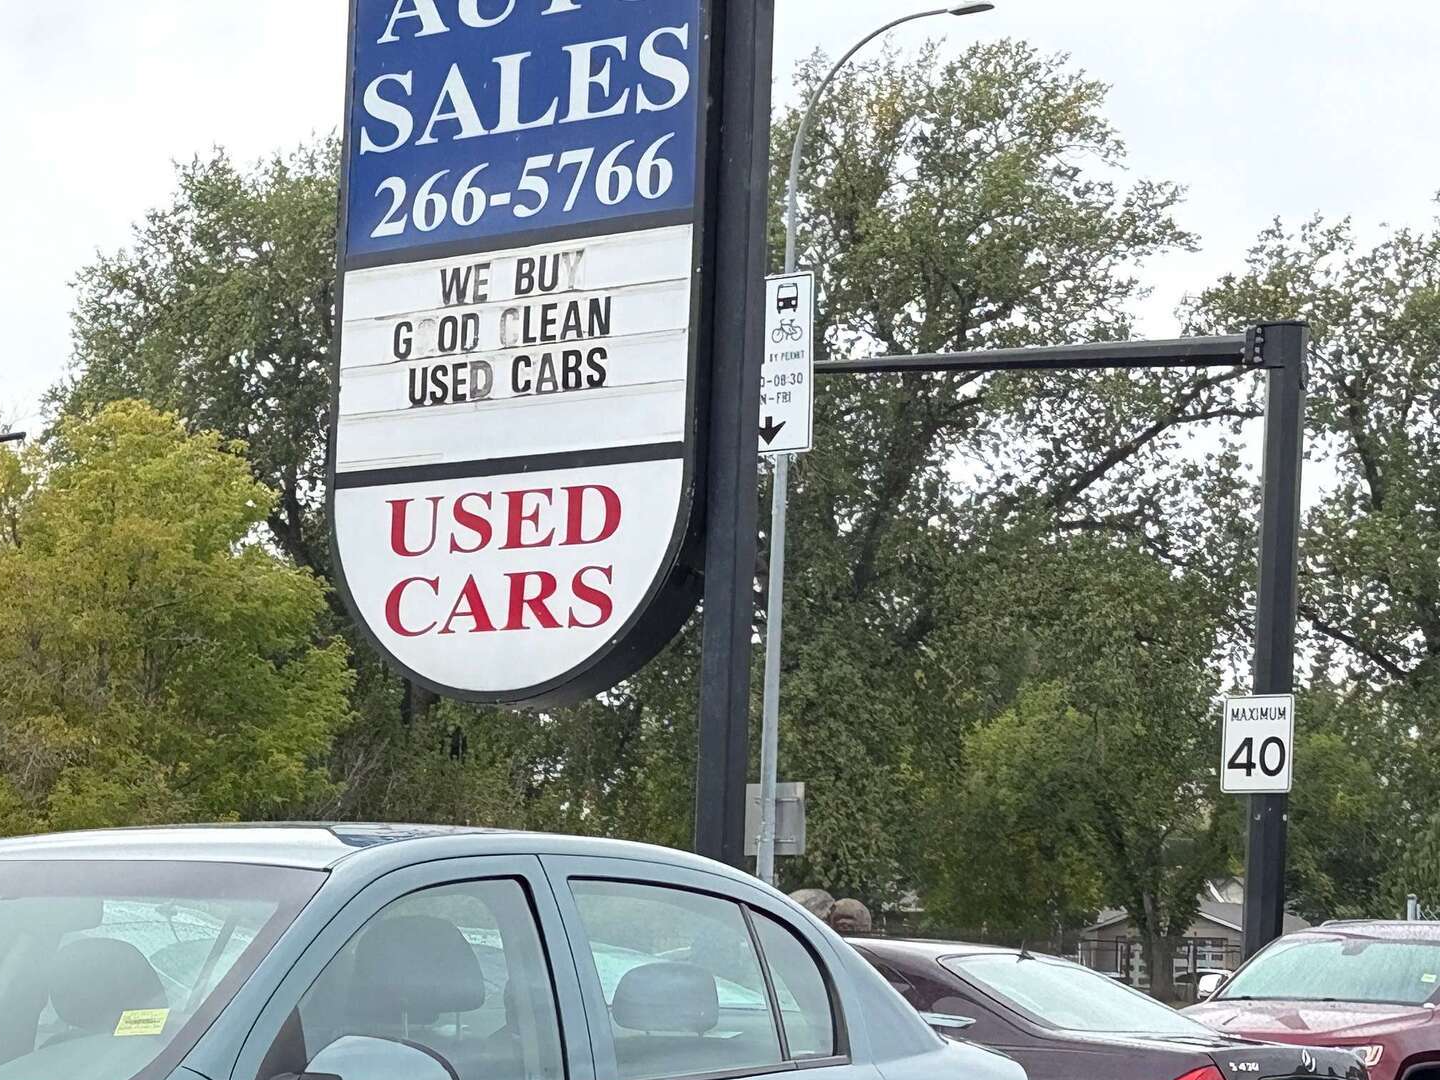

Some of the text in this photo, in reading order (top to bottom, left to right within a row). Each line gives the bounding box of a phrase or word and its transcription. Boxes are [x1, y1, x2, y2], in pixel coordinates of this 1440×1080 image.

[360, 22, 690, 155] SALES
[371, 132, 675, 238] 266-5766
[440, 248, 585, 305] WE BUY
[500, 296, 611, 348] CLEAN
[408, 360, 493, 406] USED
[386, 484, 622, 557] USED
[385, 564, 614, 636] CARS
[1230, 706, 1287, 722] MAXIMUM
[1227, 736, 1286, 776] 40
